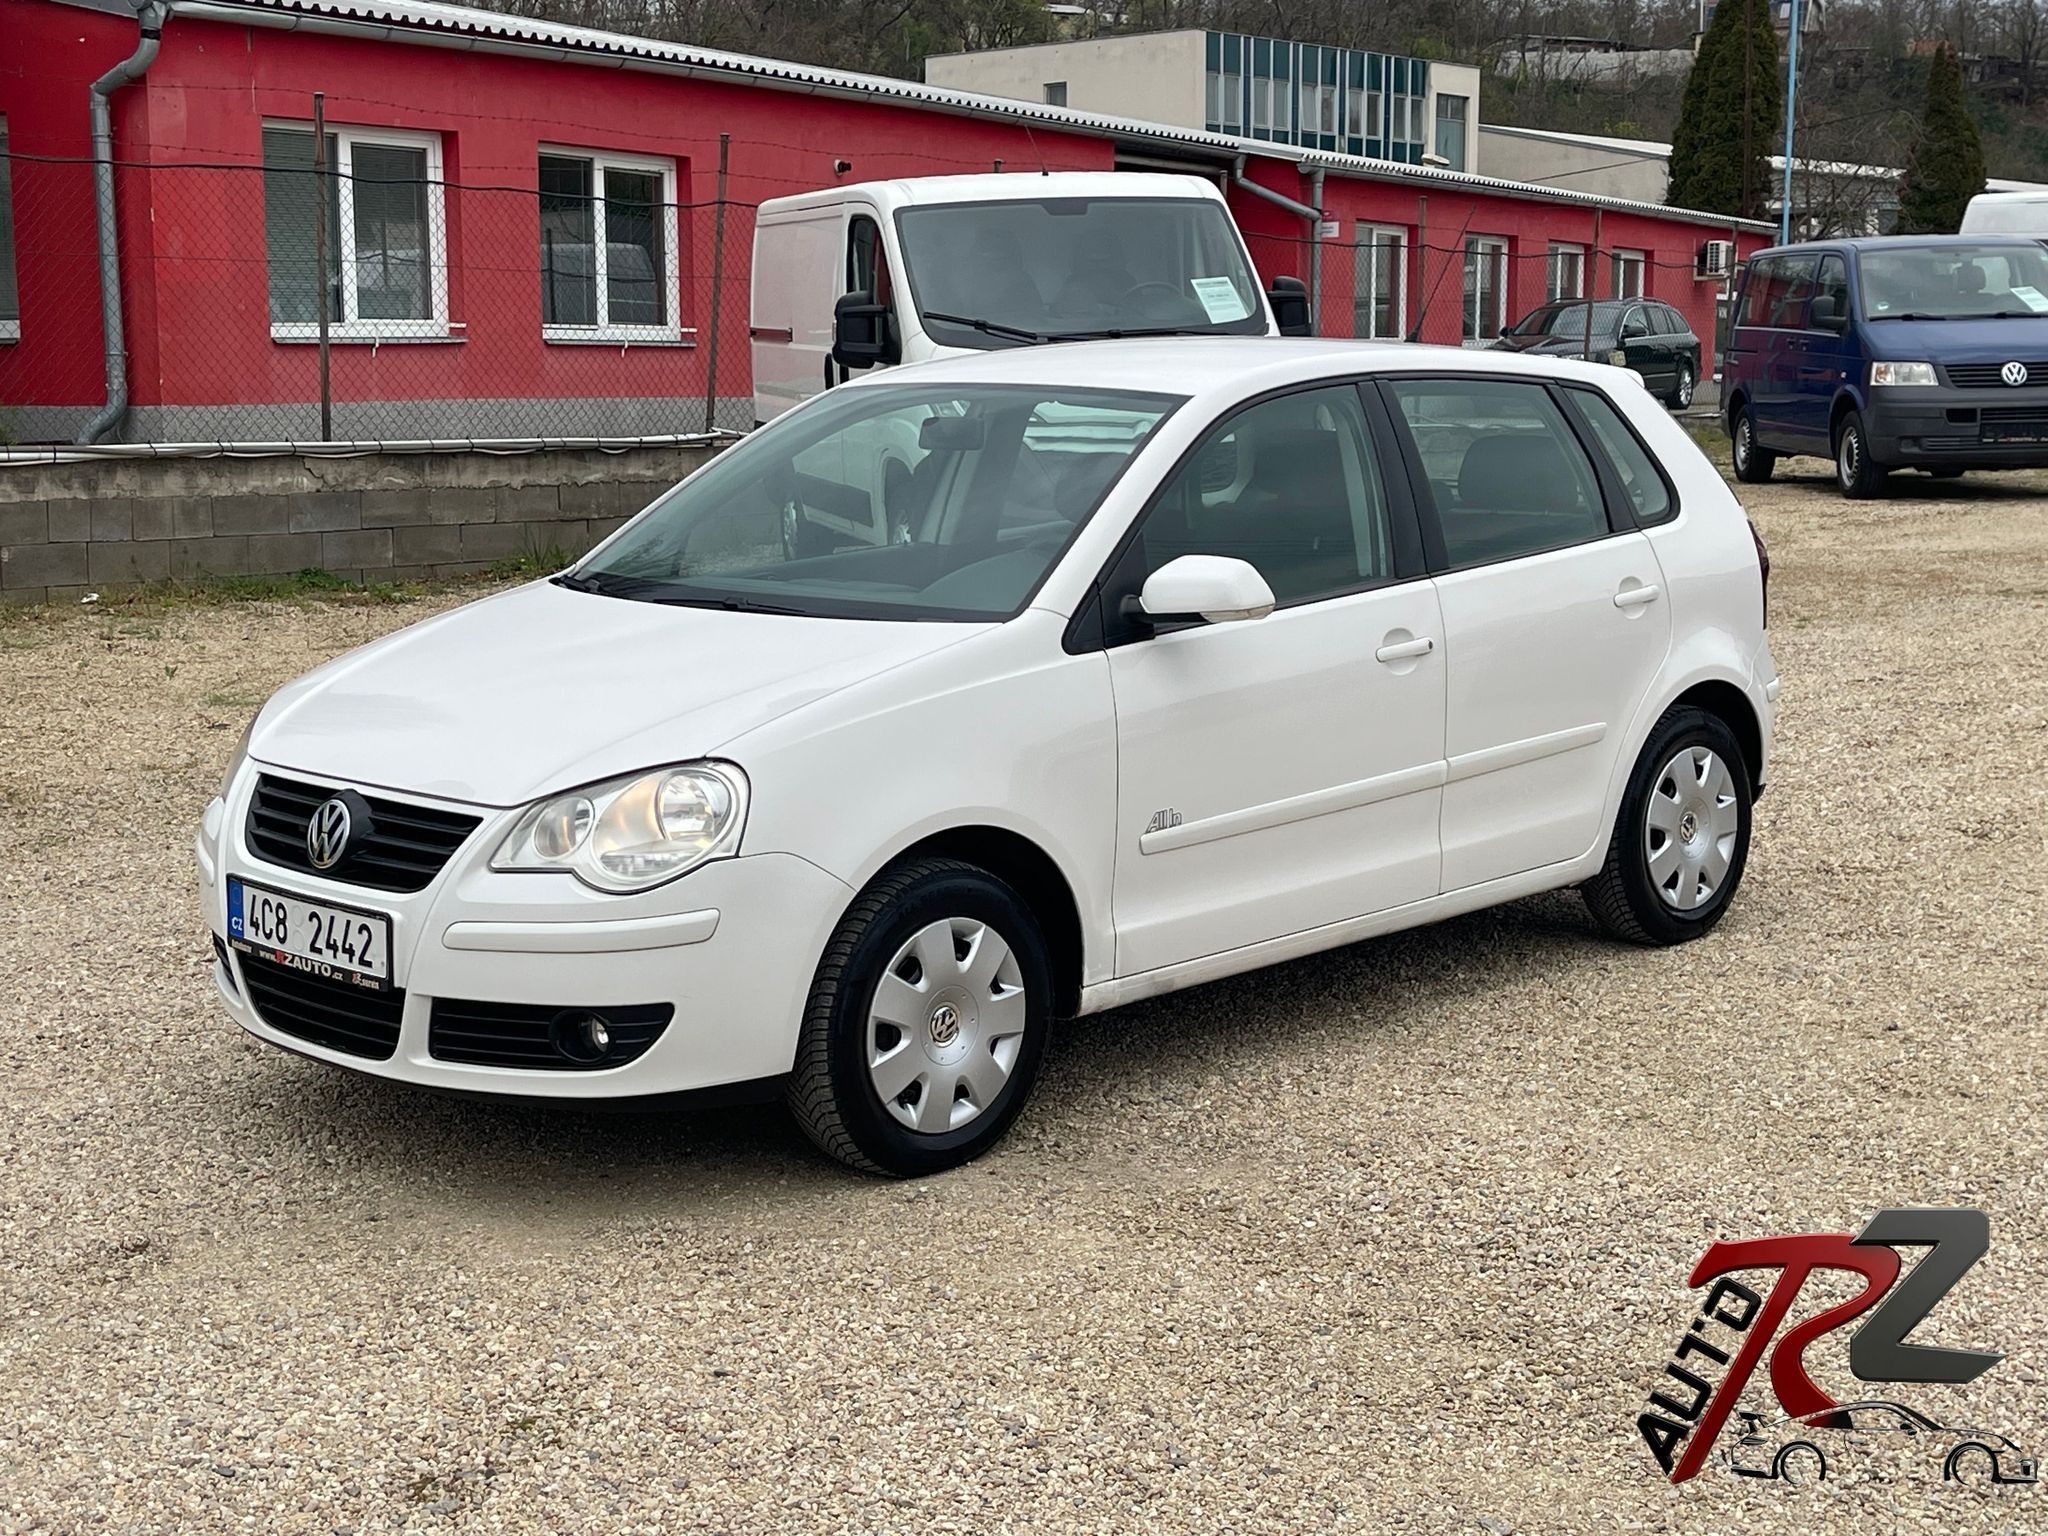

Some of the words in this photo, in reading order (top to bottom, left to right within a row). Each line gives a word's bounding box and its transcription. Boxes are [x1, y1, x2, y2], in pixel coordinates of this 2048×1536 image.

[2001, 362, 2028, 386] VW
[308, 799, 350, 869] VW
[1145, 808, 1168, 834] All
[231, 916, 243, 931] CZ
[249, 894, 288, 945] 4C8
[308, 912, 374, 969] 2442
